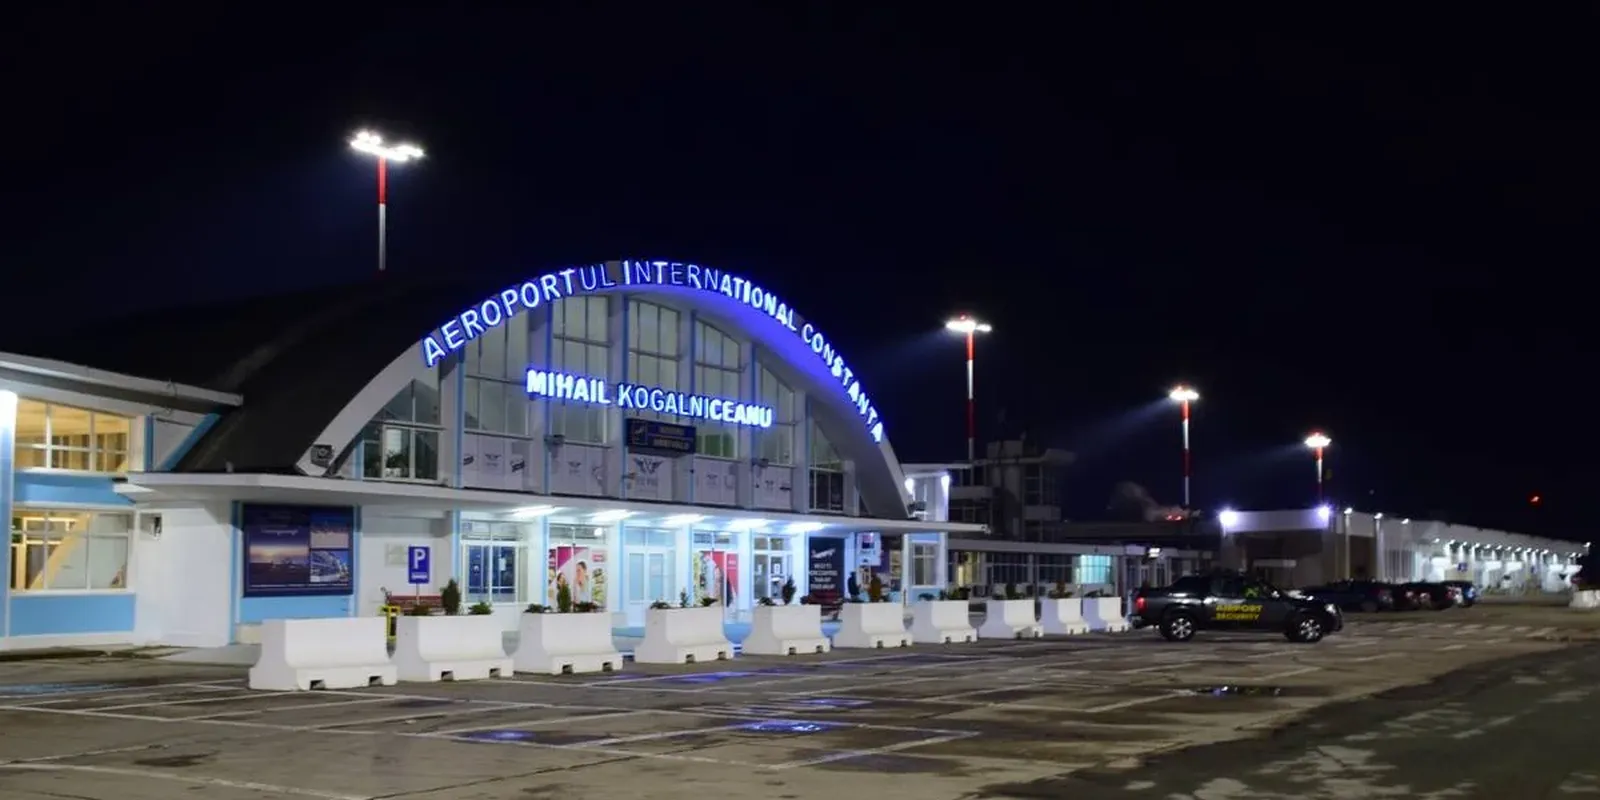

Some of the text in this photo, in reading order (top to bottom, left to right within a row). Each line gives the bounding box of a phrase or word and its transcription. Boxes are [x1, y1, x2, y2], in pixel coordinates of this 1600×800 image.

[423, 260, 884, 443] AEROPORTUL INTERNATIONAL CONSTANTA
[526, 369, 774, 428] MIHAIL KOGALNICEANU
[414, 548, 426, 569] P
[1215, 604, 1263, 612] AIRPORT
[1215, 612, 1260, 620] SECURITY
